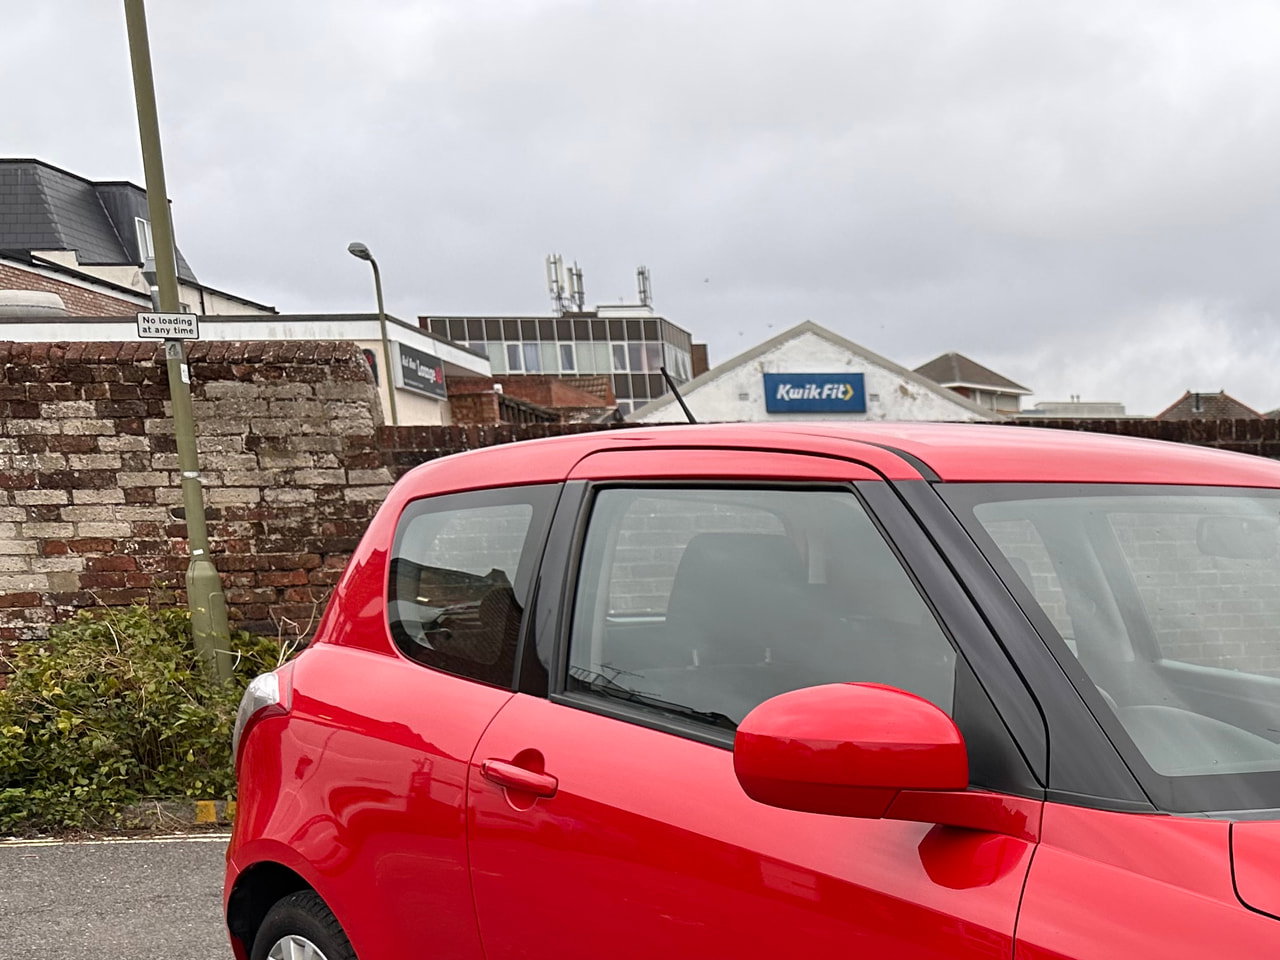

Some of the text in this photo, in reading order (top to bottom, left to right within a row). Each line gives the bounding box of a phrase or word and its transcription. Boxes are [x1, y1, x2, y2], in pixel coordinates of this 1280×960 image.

[142, 316, 193, 327] No loading
[154, 327, 171, 335] any
[173, 327, 194, 335] time
